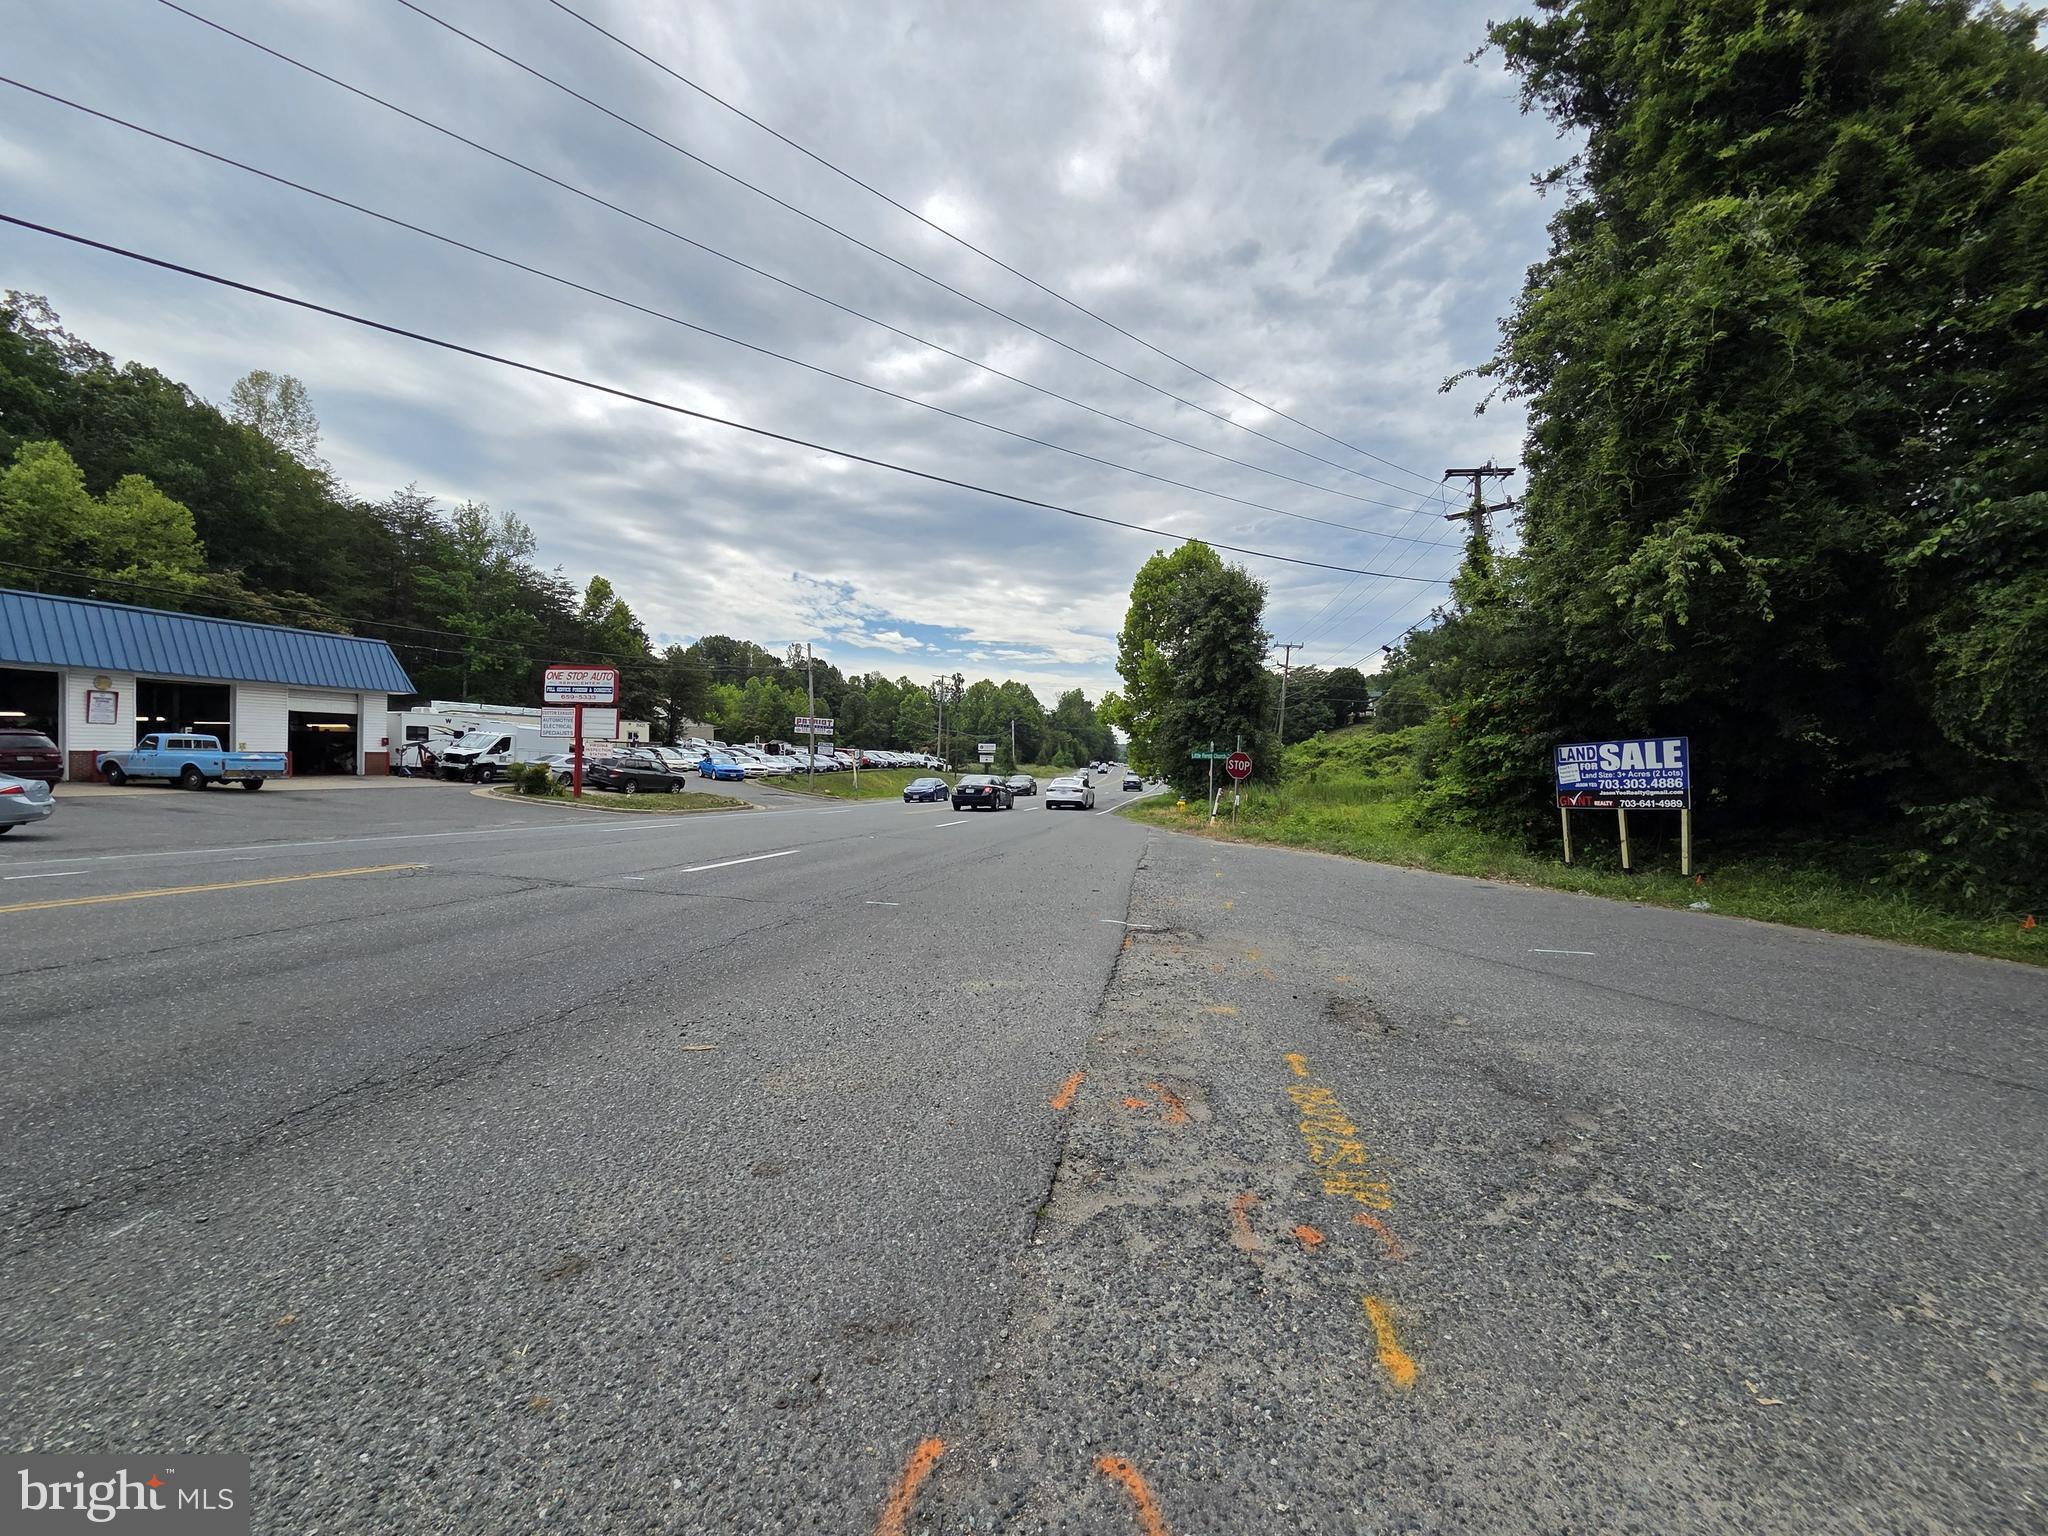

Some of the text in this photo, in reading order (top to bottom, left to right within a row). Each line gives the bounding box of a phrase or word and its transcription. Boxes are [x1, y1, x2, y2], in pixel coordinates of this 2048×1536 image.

[546, 671, 614, 681] ONE STOP AUTO
[1559, 740, 1683, 770] LAND SALE
[1228, 760, 1250, 771] STOP
[1580, 762, 1598, 771] FOR
[1628, 770, 1651, 778] Acres
[1652, 770, 1661, 778] (2
[1662, 769, 1684, 778] Lots)
[1598, 778, 1684, 789] 703.303.4886
[1619, 799, 1683, 807] 703-641-4989
